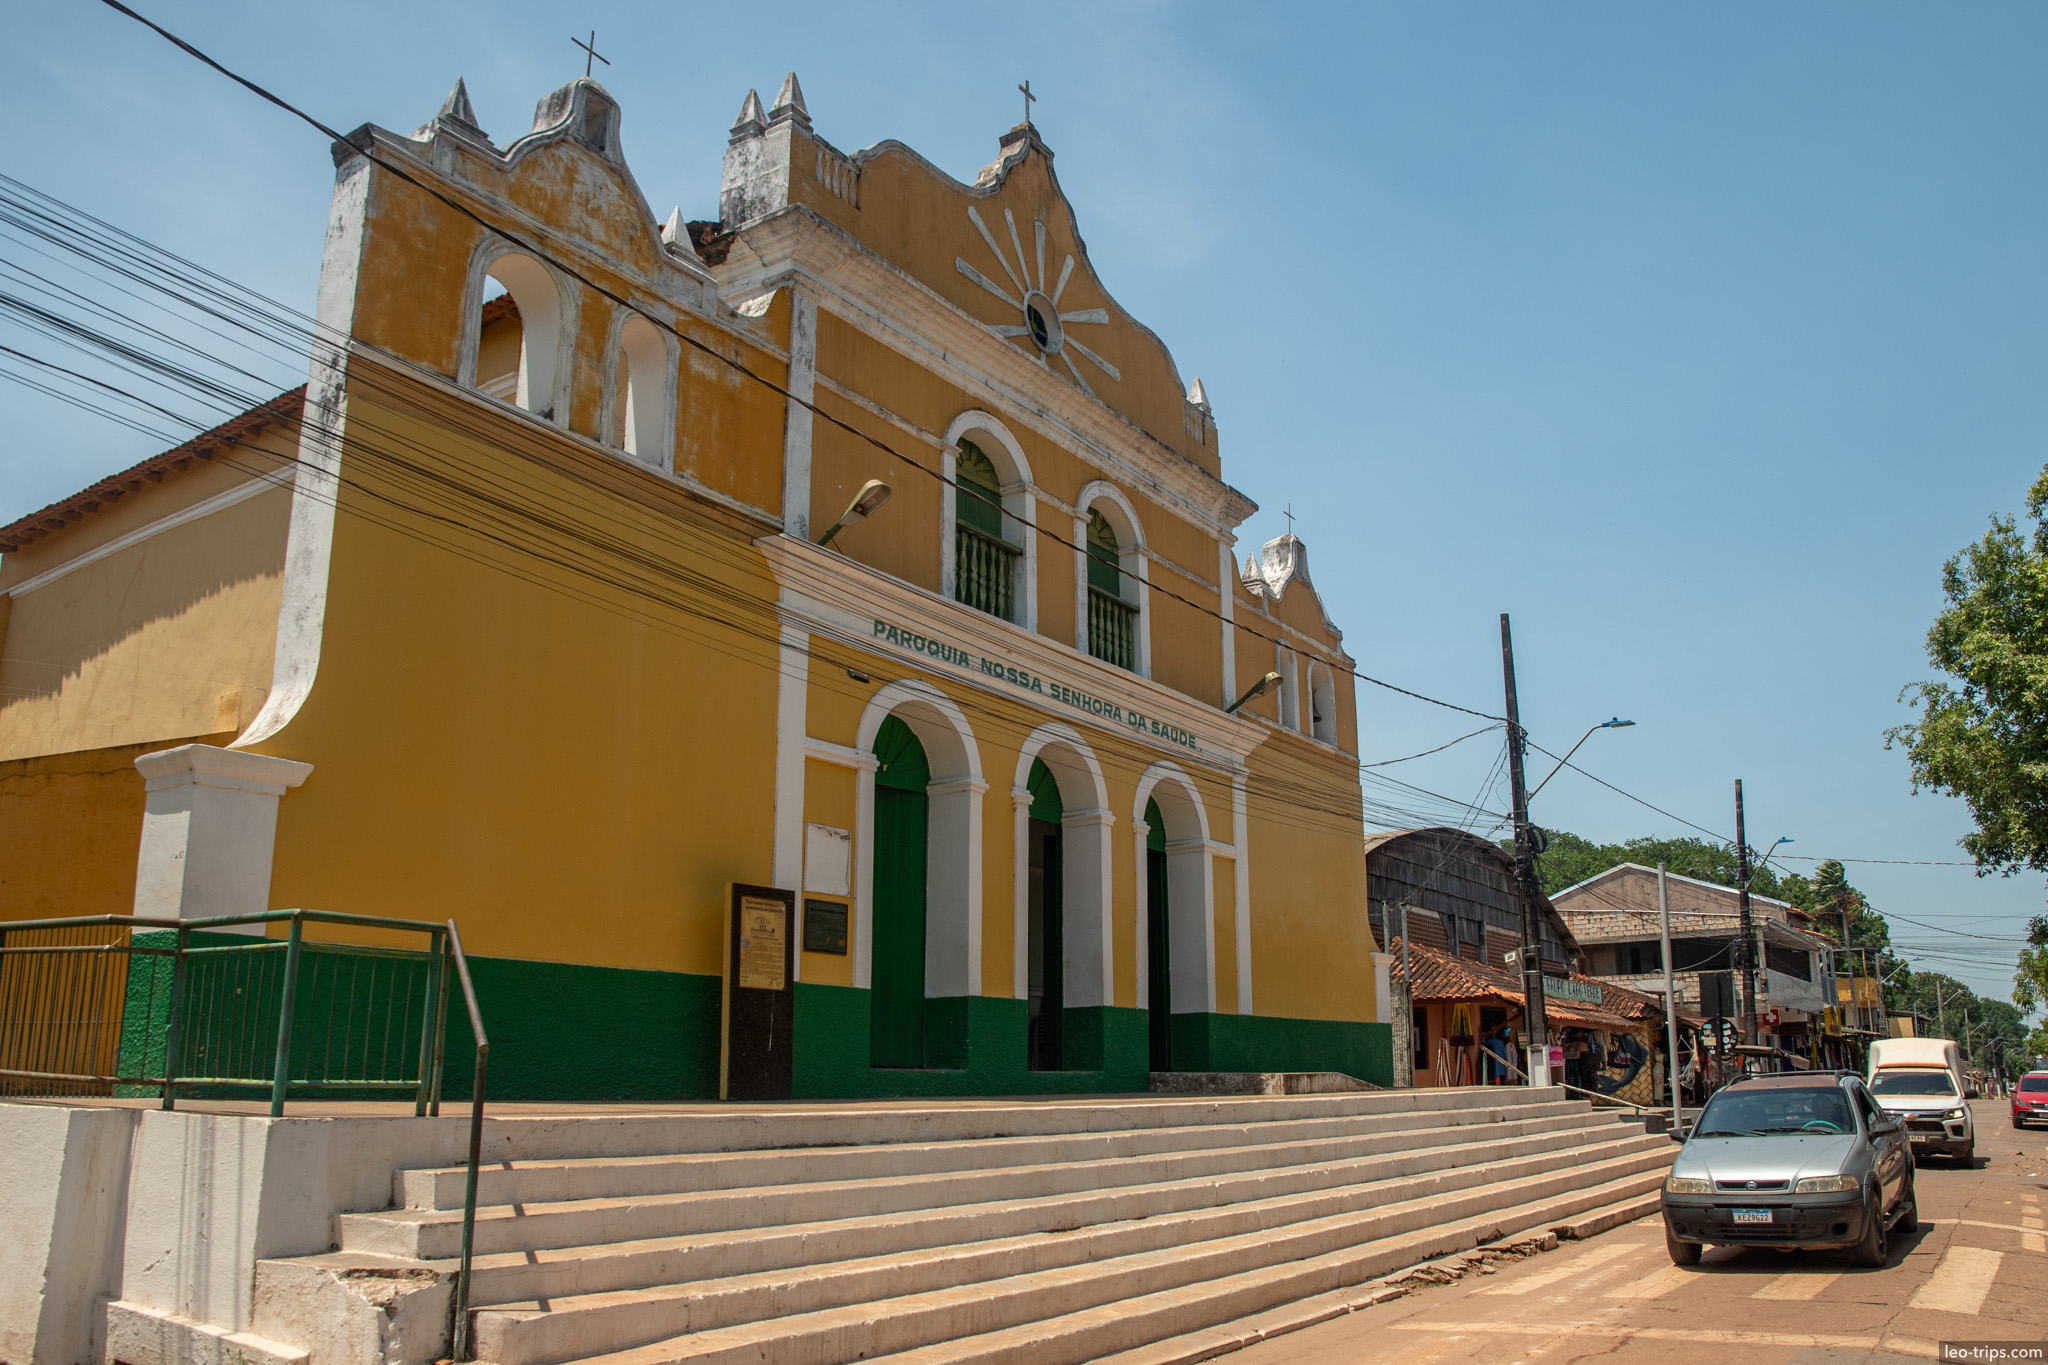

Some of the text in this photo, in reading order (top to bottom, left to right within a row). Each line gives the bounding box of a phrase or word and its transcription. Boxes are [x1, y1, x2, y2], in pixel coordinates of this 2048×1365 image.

[980, 657, 1043, 693] NOSSA
[1050, 683, 1122, 721] SENHORA
[1128, 711, 1147, 731] DA
[1151, 720, 1197, 749] SAÚDE
